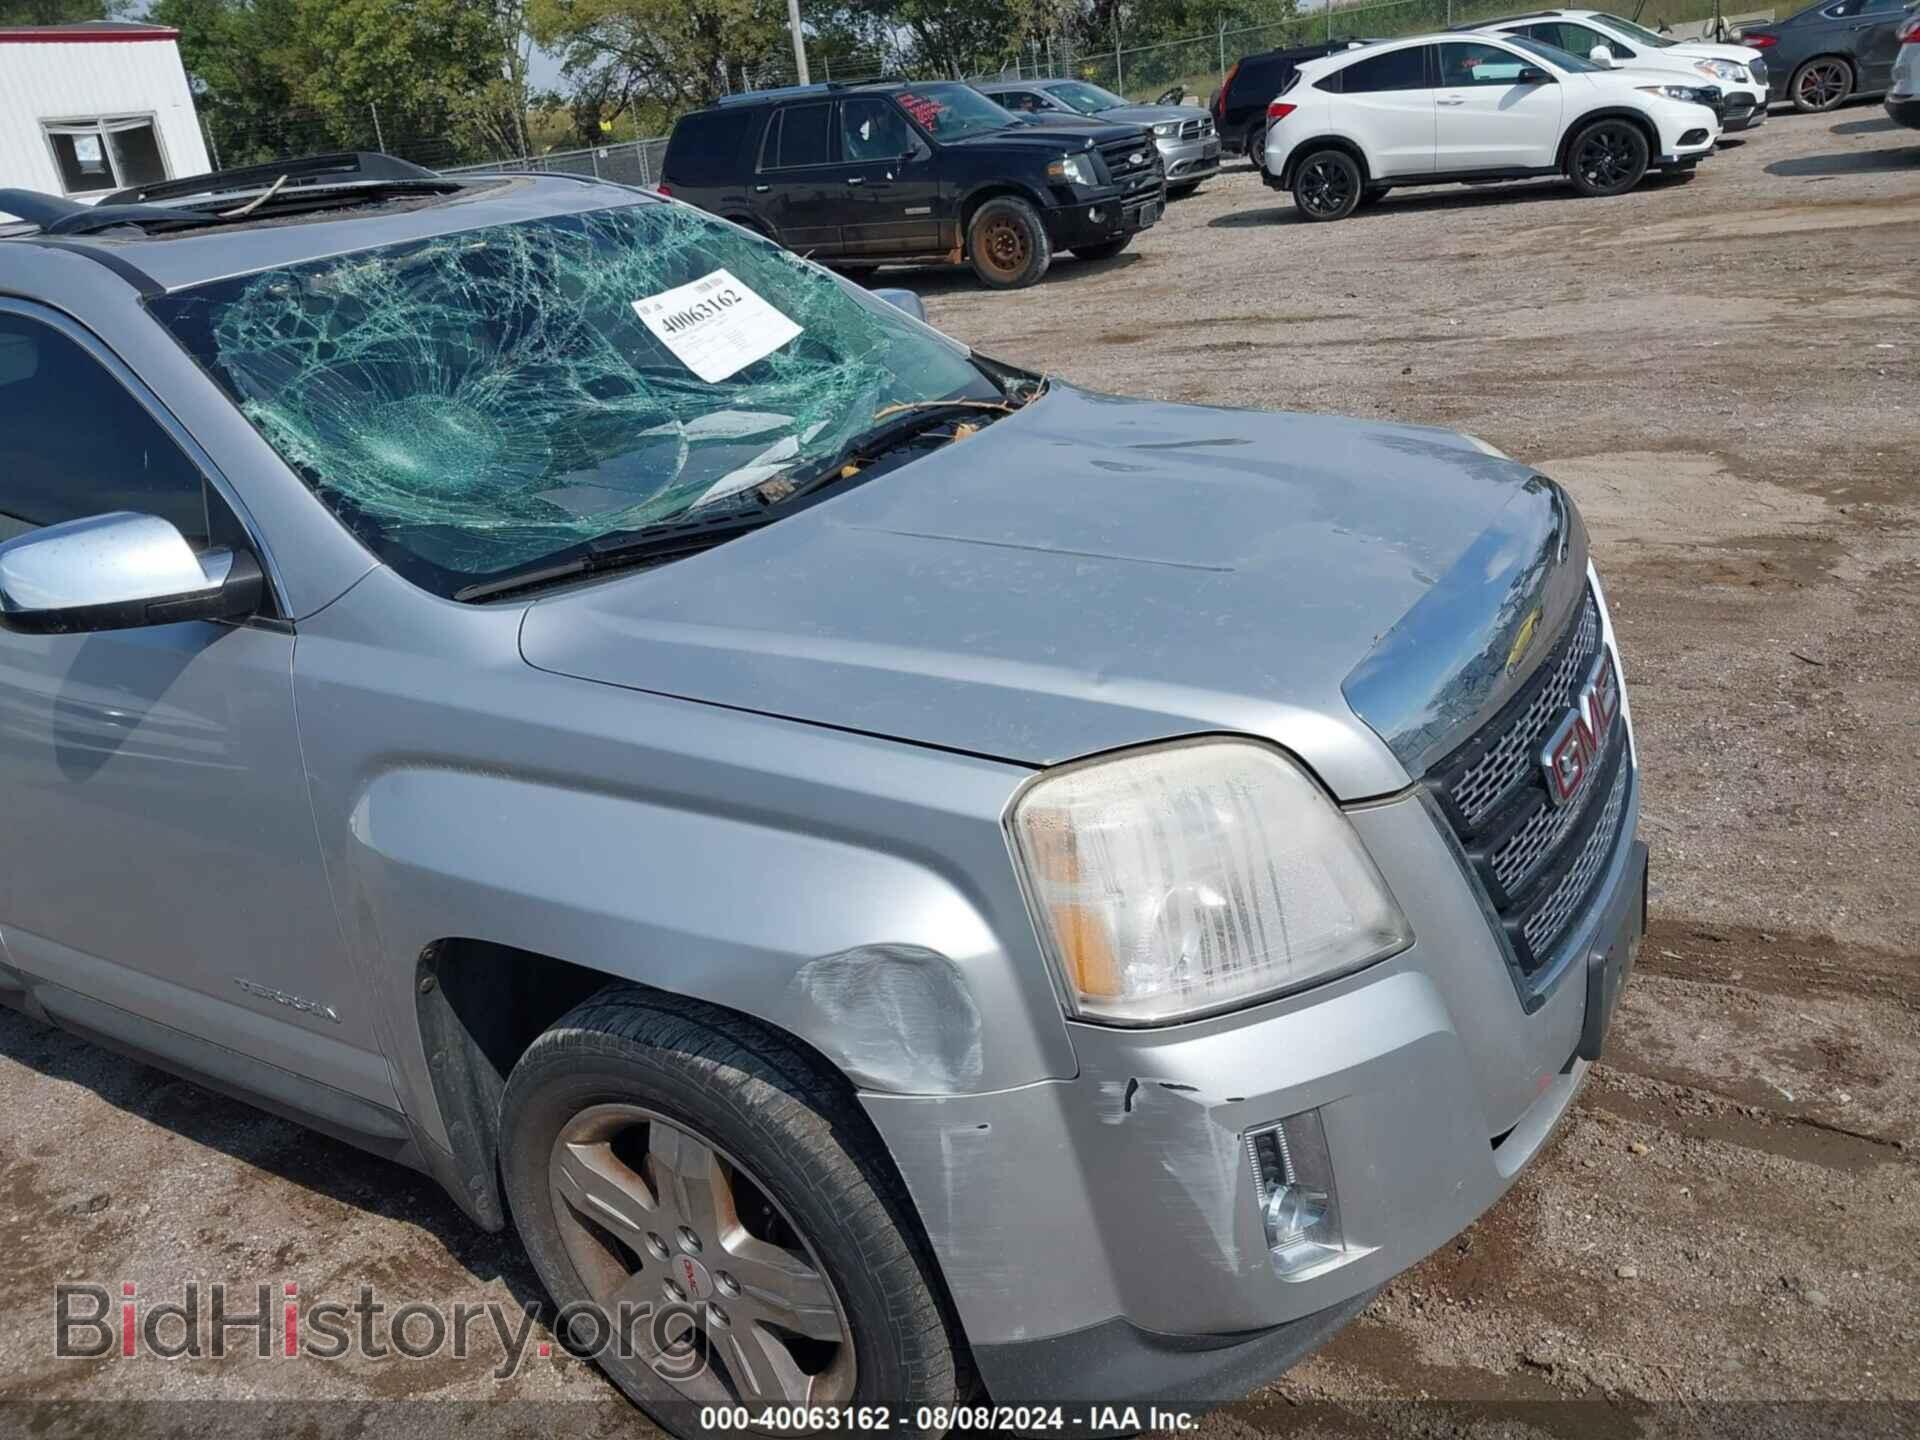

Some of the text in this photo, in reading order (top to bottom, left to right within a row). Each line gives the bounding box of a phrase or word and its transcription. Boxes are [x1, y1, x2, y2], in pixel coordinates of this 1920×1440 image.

[662, 289, 742, 333] 40063162
[1546, 649, 1619, 802] GMC
[682, 1258, 701, 1297] GMC
